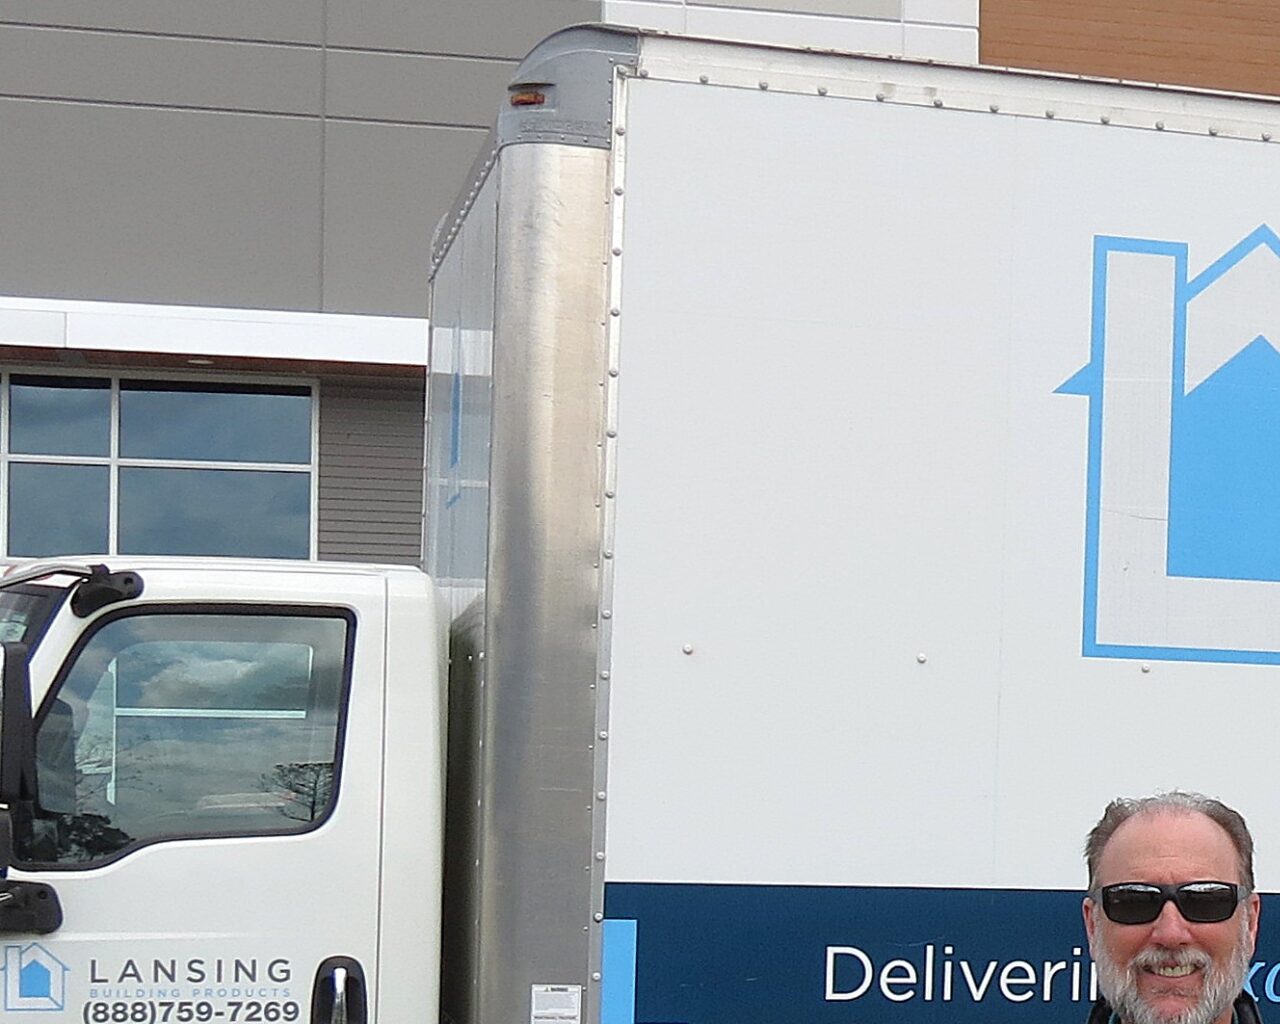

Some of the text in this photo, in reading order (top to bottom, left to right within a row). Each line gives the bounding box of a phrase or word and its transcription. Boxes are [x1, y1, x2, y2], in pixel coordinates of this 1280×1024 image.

[90, 958, 291, 984] LANSING
[825, 945, 1098, 1001] Deliveri
[89, 988, 291, 998] BUILDING PRODUCTS
